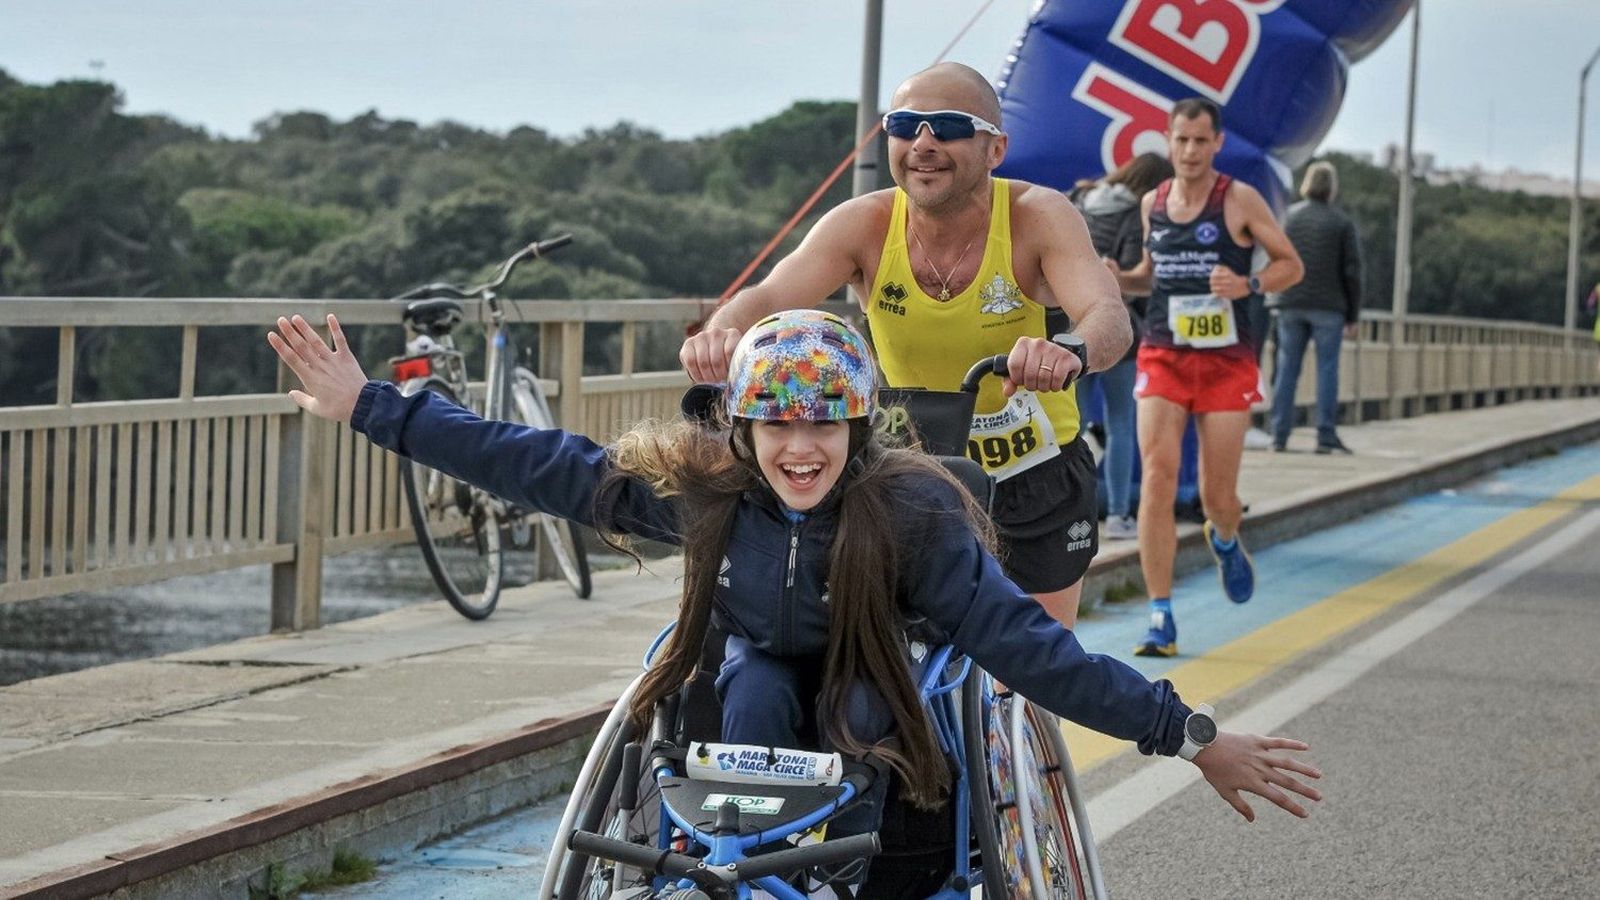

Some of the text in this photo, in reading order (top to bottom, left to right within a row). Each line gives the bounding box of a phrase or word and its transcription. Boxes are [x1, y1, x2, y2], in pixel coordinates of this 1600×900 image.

[1186, 314, 1223, 337] 798
[739, 750, 808, 765] MARTONA
[737, 760, 771, 772] MAGA
[774, 764, 806, 775] CIRCE
